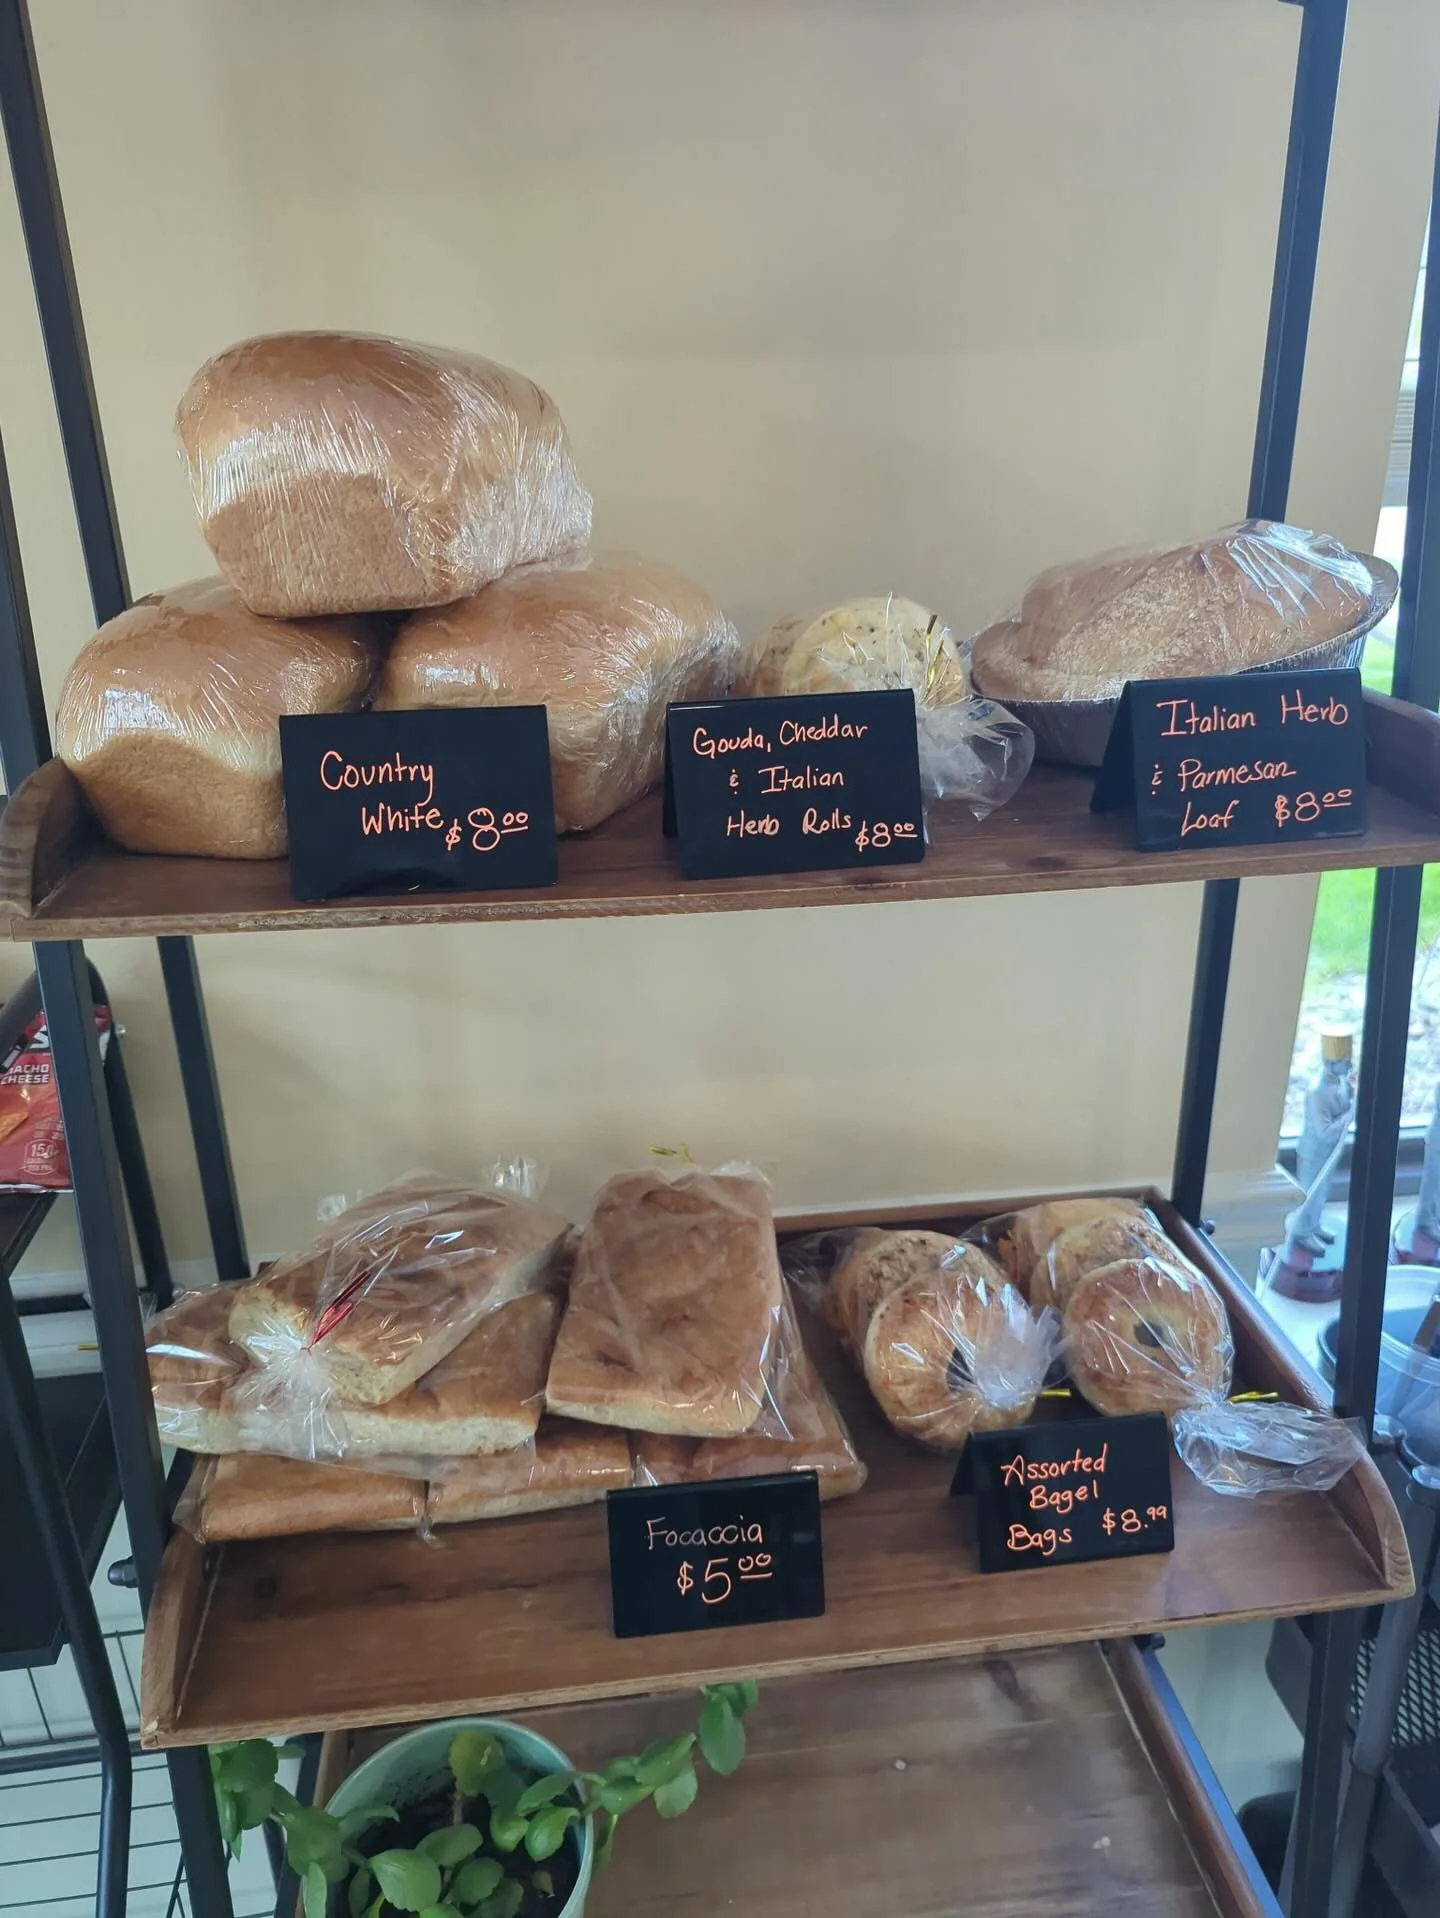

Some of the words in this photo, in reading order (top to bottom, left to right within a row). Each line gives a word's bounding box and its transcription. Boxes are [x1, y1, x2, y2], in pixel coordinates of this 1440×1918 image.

[1155, 699, 1257, 737] Italian
[1280, 688, 1350, 726] Herb
[692, 727, 772, 760] Gouda,
[779, 713, 869, 746] Cheddar
[320, 750, 434, 807] Country
[757, 765, 845, 794] Italian
[1177, 758, 1298, 793] Parmesan
[361, 802, 445, 836] White
[726, 809, 781, 838] Herb
[802, 807, 852, 835] Rolls
[1180, 799, 1241, 837] Loaf
[1000, 1442, 1109, 1488] Assorted
[1029, 1479, 1100, 1515] Bagel
[646, 1514, 764, 1551] Focaccia
[1006, 1523, 1073, 1557] Bags
[1102, 1505, 1169, 1536] $8.99
